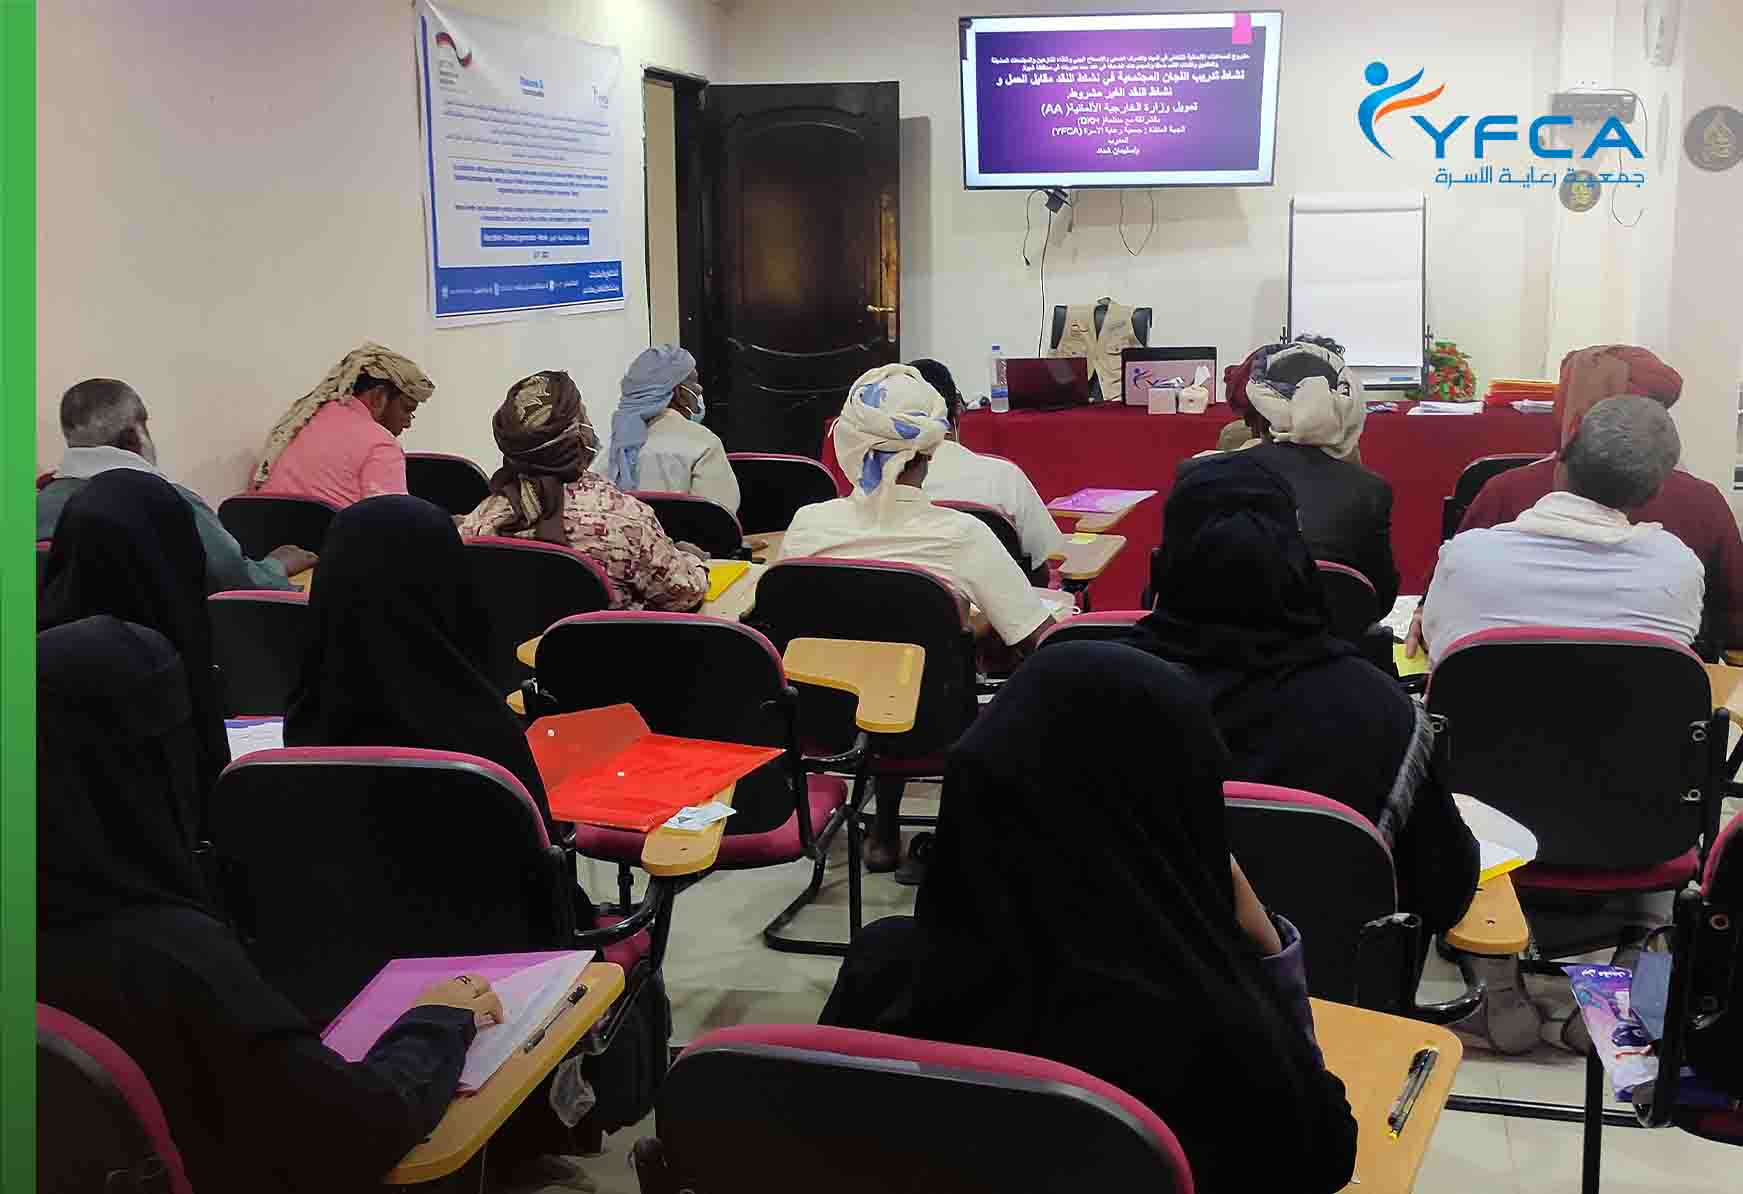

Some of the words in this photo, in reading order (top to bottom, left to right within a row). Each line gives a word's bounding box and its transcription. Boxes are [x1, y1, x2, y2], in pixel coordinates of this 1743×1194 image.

[1005, 73, 1028, 86] العمل
[1030, 72, 1054, 86] مقابل
[1077, 71, 1100, 83] نشاط
[1102, 71, 1116, 86] في
[1118, 71, 1161, 84] المجتمعية
[1163, 71, 1190, 82] اللجان
[1192, 70, 1220, 82] تدريب
[1221, 69, 1245, 80] نشاط
[995, 77, 1004, 87] و
[1148, 87, 1172, 97] نشاط
[1104, 102, 1142, 114] الخارجية
[1144, 102, 1171, 114] وزارة
[1173, 102, 1198, 113] تمويل
